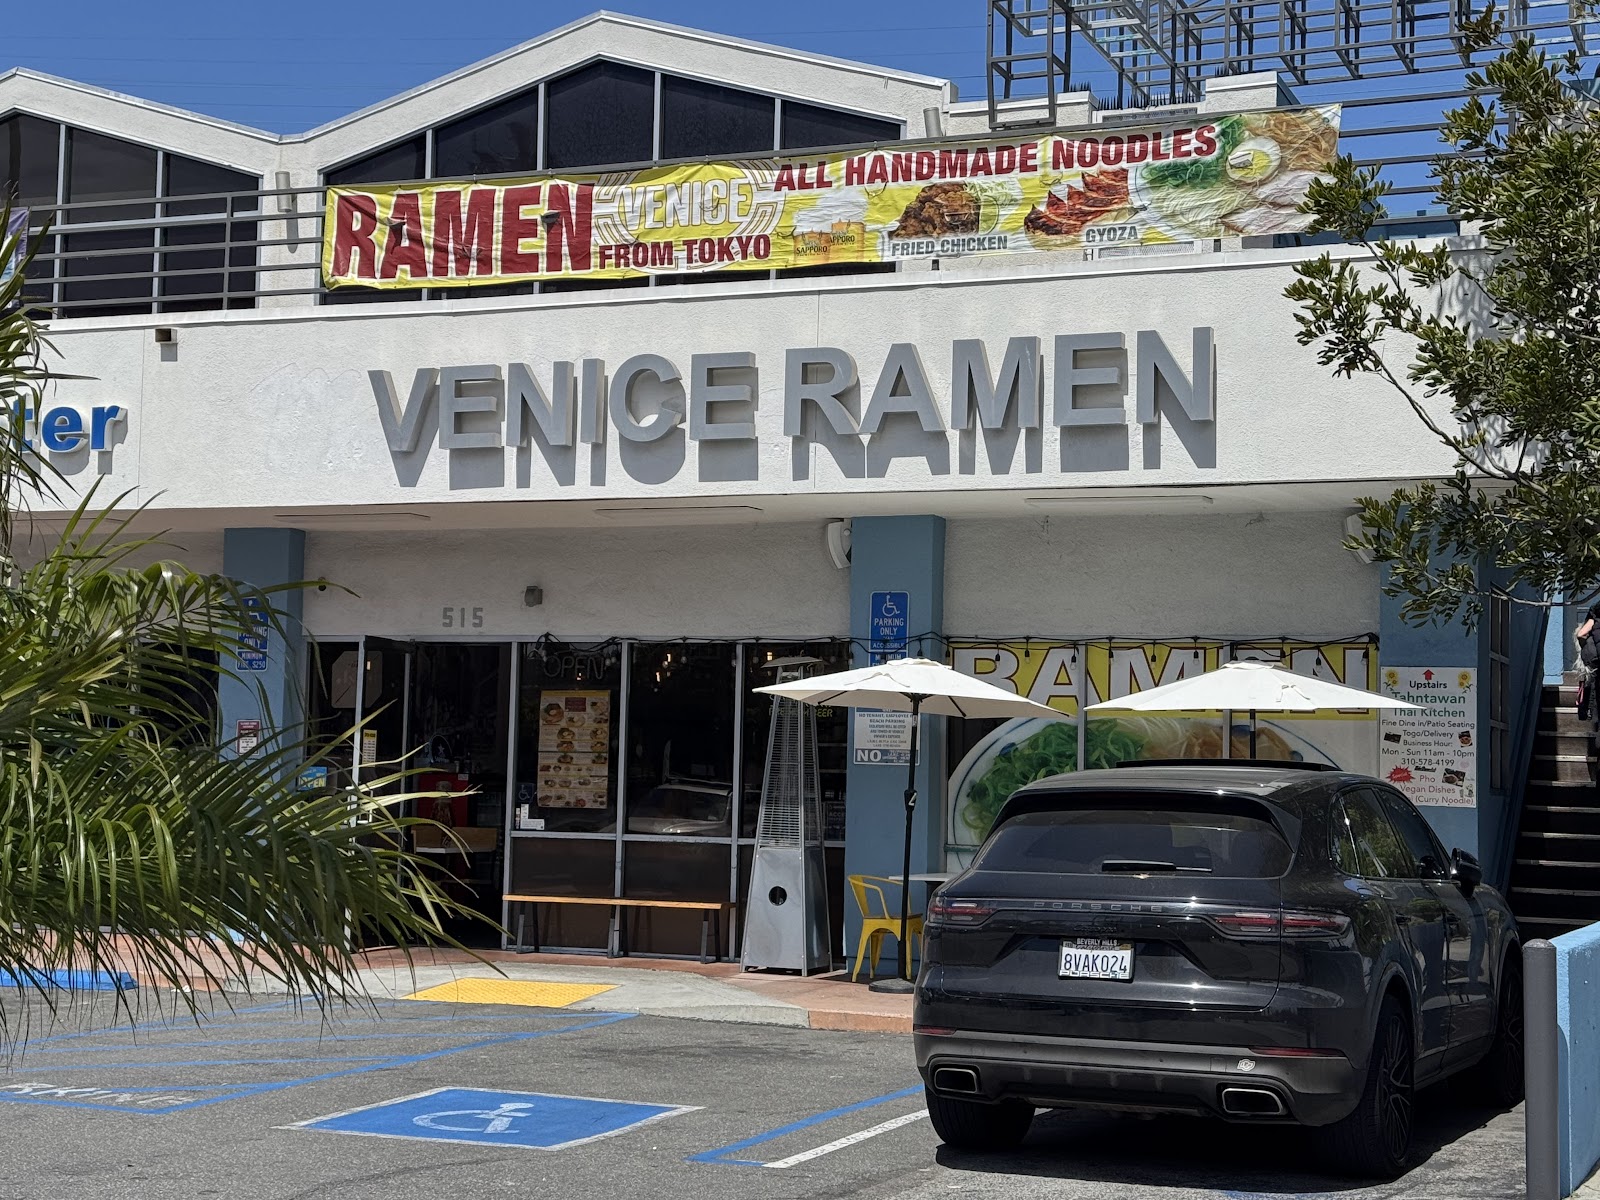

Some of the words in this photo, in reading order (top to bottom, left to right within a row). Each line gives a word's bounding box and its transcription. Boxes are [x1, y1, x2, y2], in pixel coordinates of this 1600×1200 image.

[773, 156, 832, 192] ALL
[845, 141, 1038, 187] HANDMADE
[1052, 125, 1217, 171] NOODLES
[620, 177, 751, 231] VENICE
[331, 182, 596, 280] RAMEN
[1085, 225, 1139, 244] GYOZA
[598, 241, 674, 270] FROM
[682, 233, 771, 266] TOKYO
[891, 238, 936, 257] FRIED
[940, 234, 1008, 253] CHICKEN
[367, 351, 760, 453] VENICE
[783, 326, 1214, 437] RAMEN
[442, 607, 484, 628] 515
[874, 617, 904, 627] PARKING
[879, 627, 898, 636] ONLY
[1409, 680, 1448, 690] Upstairs
[1391, 691, 1466, 704] Tahntawan
[1420, 706, 1466, 718] Kitchen
[1398, 719, 1416, 727] Dine
[1447, 720, 1475, 730] Seating
[1402, 729, 1454, 740] Togo/Delivery
[1402, 739, 1433, 747] Business
[856, 749, 882, 762] NO
[1381, 747, 1400, 755] Mon
[1406, 748, 1421, 756] Sun
[1423, 749, 1445, 757] 11am
[1452, 749, 1475, 759] 10pm
[1400, 757, 1455, 767] 310-578-4199
[1419, 774, 1436, 783] Pho
[1428, 785, 1456, 794] Dishes
[1033, 901, 1162, 913] PORSCHE
[1063, 953, 1128, 974] 8VAK024
[1059, 970, 1130, 980] PORSCHE
